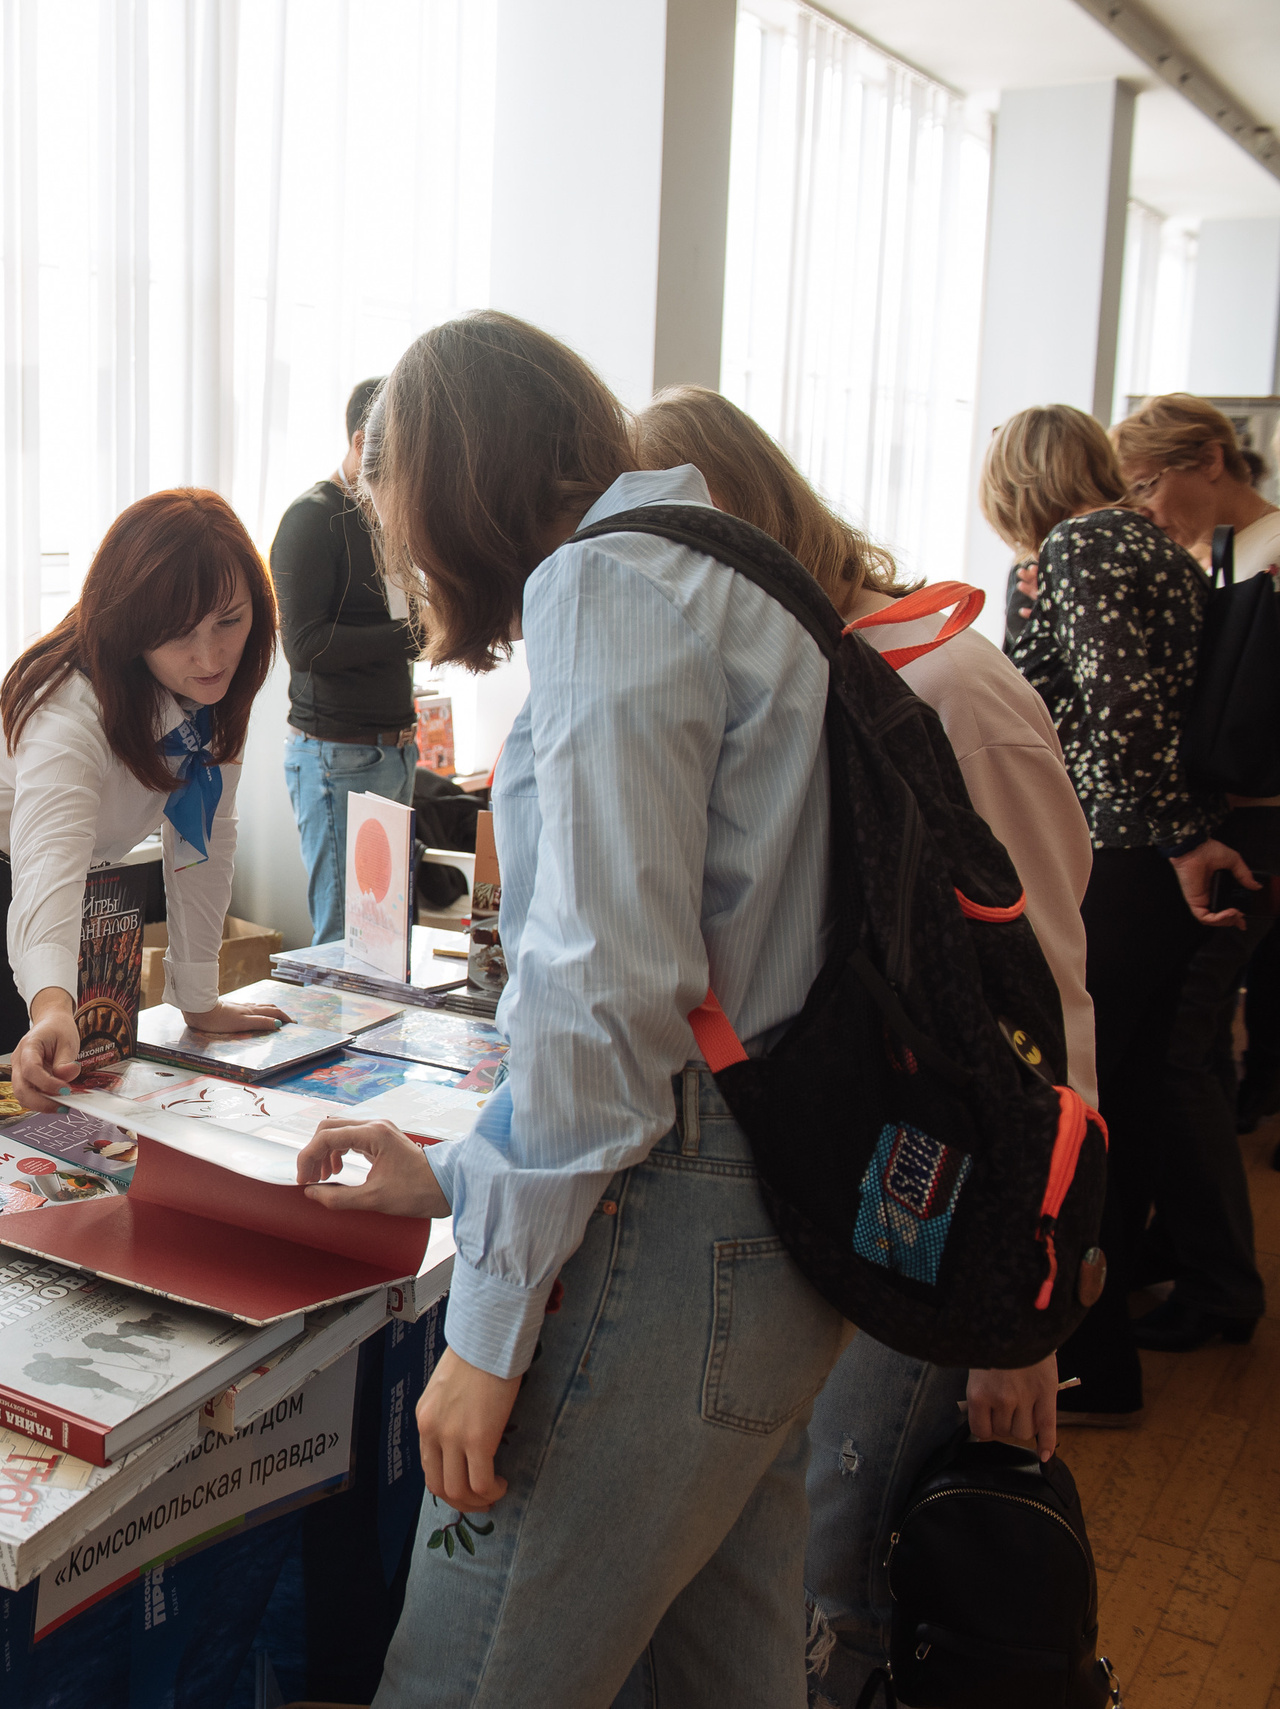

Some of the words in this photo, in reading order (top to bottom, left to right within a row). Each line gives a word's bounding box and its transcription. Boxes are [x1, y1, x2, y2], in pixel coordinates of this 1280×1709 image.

[25, 1321, 45, 1333] ВСЕ
[45, 1291, 104, 1324] ДОКУМЕНТЫ
[39, 1310, 84, 1335] ГЛАВНЫЕ
[61, 1314, 107, 1342] ИСТОРИИ
[106, 1304, 130, 1319] ВЕКА
[43, 1321, 81, 1343] САМОЙ
[4, 1410, 53, 1440] ТАЙНА
[26, 1409, 38, 1418] ВСЕ
[260, 1392, 305, 1434] дом
[393, 1378, 405, 1480] ПРАВДА
[54, 1467, 242, 1588] «Комсомольская
[249, 1432, 340, 1486] правда»
